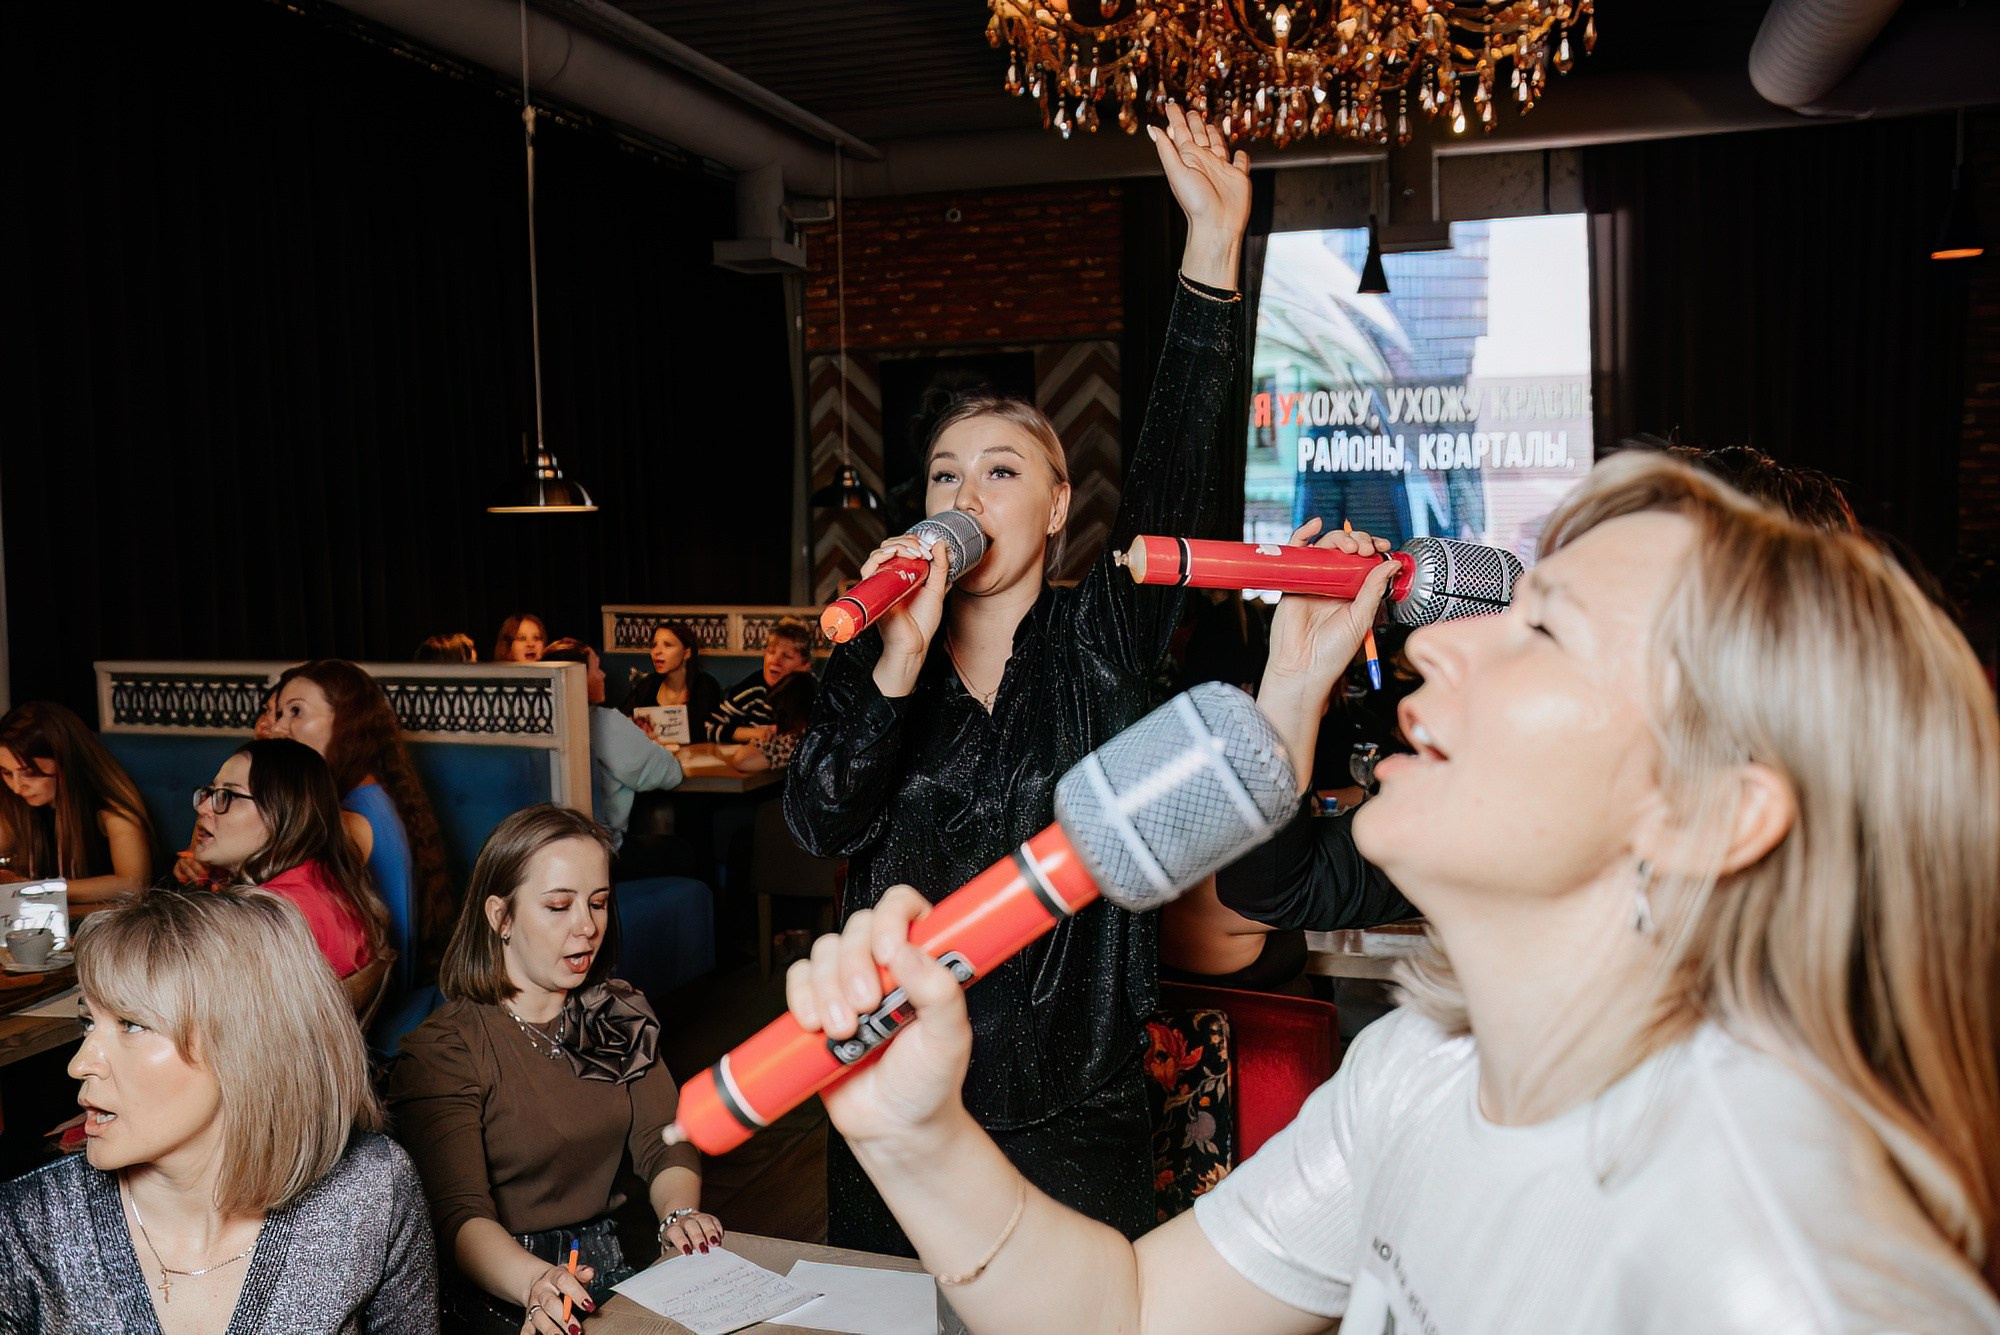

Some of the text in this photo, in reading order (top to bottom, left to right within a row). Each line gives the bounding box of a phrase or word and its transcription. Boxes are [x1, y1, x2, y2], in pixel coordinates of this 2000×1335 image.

[1254, 392, 1272, 428] Я
[1277, 387, 1379, 430] УХОЖУ,
[1386, 386, 1484, 424] УХОЖУ
[1298, 429, 1576, 475] РАЙОНЫ, КВАРТАЛЫ,
